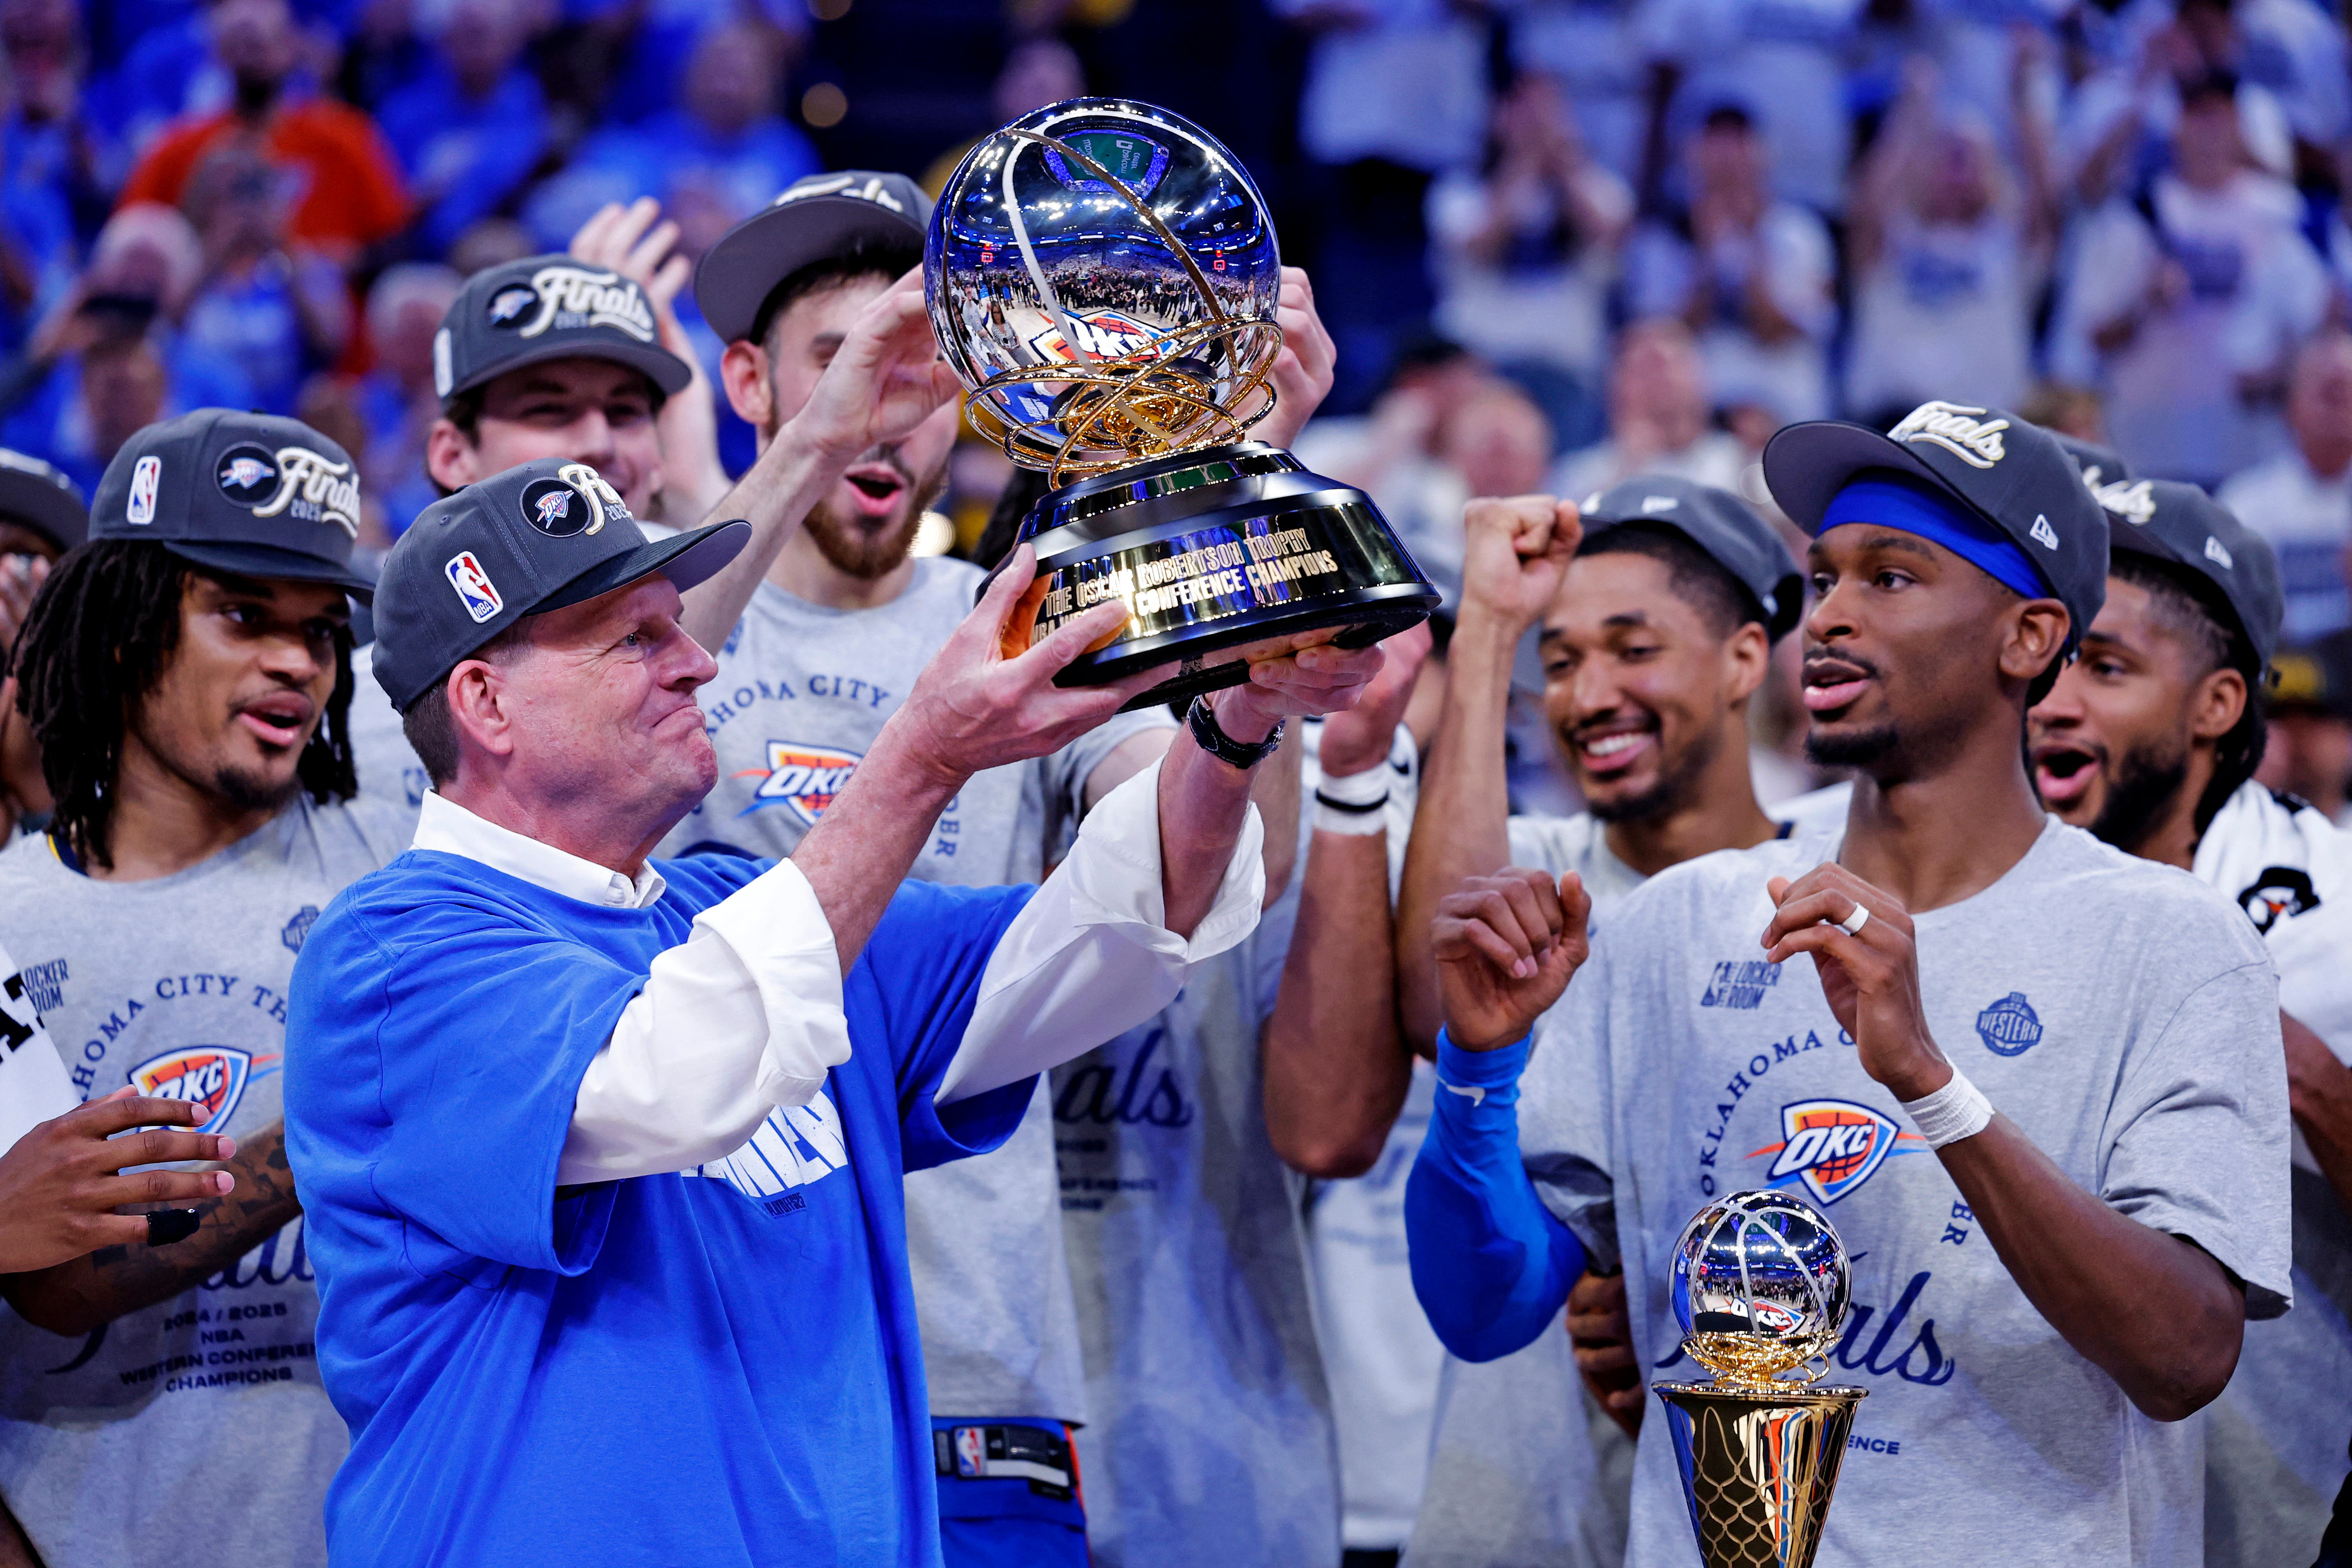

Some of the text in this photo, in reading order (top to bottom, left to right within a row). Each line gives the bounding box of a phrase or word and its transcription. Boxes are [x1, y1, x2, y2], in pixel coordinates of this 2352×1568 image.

[520, 267, 654, 342] Finals
[544, 495, 562, 521] OKC
[1045, 527, 1312, 618] THE OSCAR ROBERTSON TROPHY
[1135, 568, 1246, 616] CONFERENCE
[1245, 549, 1339, 587] CHAMPIONS
[473, 600, 493, 619] NBA
[808, 674, 890, 708] CITY
[25, 958, 69, 990] OCKER
[156, 973, 239, 1000] CITY
[32, 985, 64, 1012] OOM
[1980, 1012, 2040, 1041] WESTERN
[1700, 1029, 1824, 1197] OKLAHOMA
[1772, 1124, 1873, 1177] OKC
[200, 1328, 246, 1344] NBA
[120, 1353, 204, 1385] WESTERN
[166, 1367, 293, 1392] CHAMPIONS
